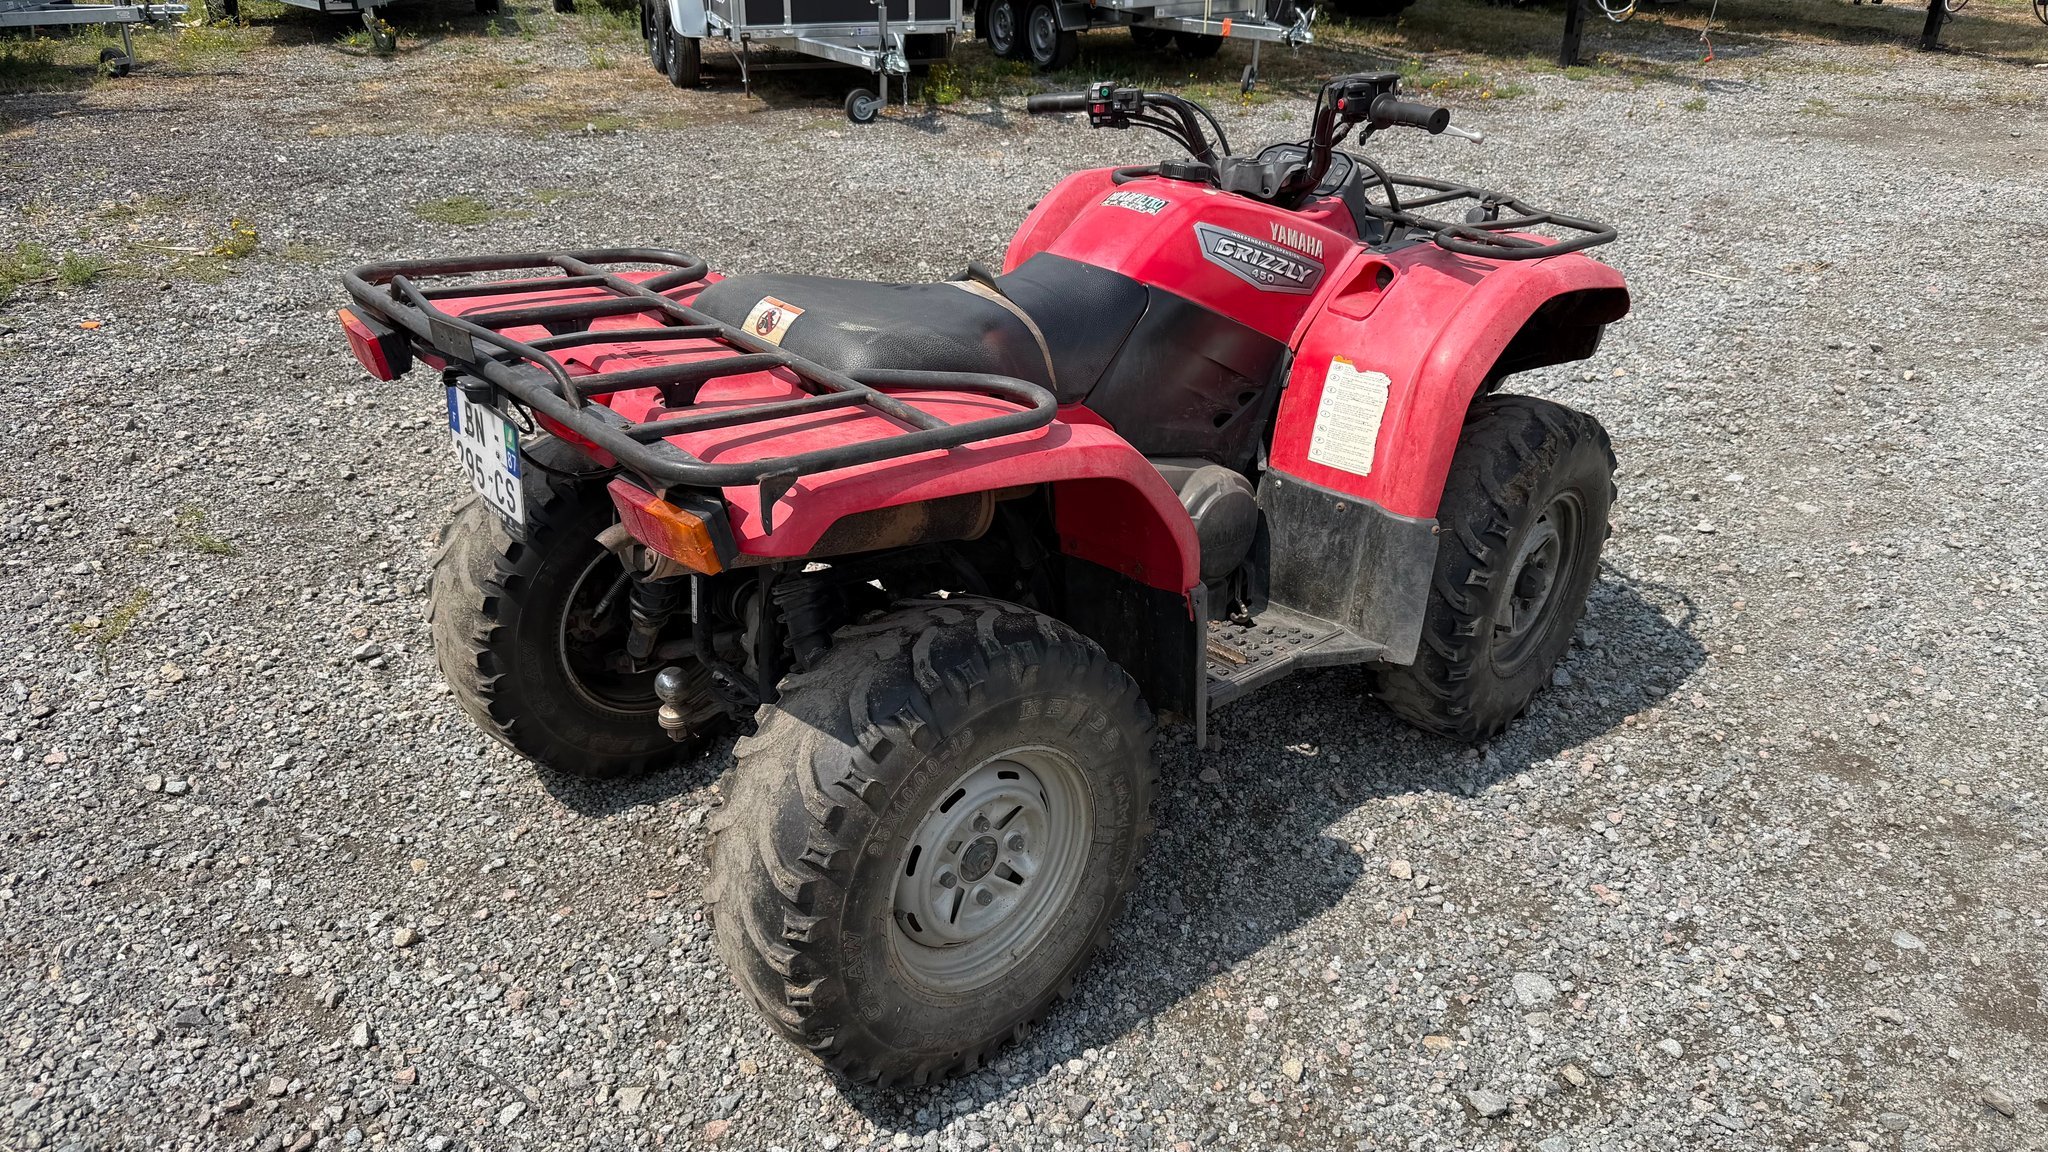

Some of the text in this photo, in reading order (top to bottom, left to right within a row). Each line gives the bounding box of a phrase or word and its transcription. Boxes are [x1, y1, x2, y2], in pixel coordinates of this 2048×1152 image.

[1231, 231, 1300, 260] INDEPENDENT SUSPENSION
[1270, 221, 1323, 259] YAMAHA
[1213, 237, 1314, 284] GRIZZLY
[1251, 268, 1275, 284] 450
[507, 450, 517, 472] 87
